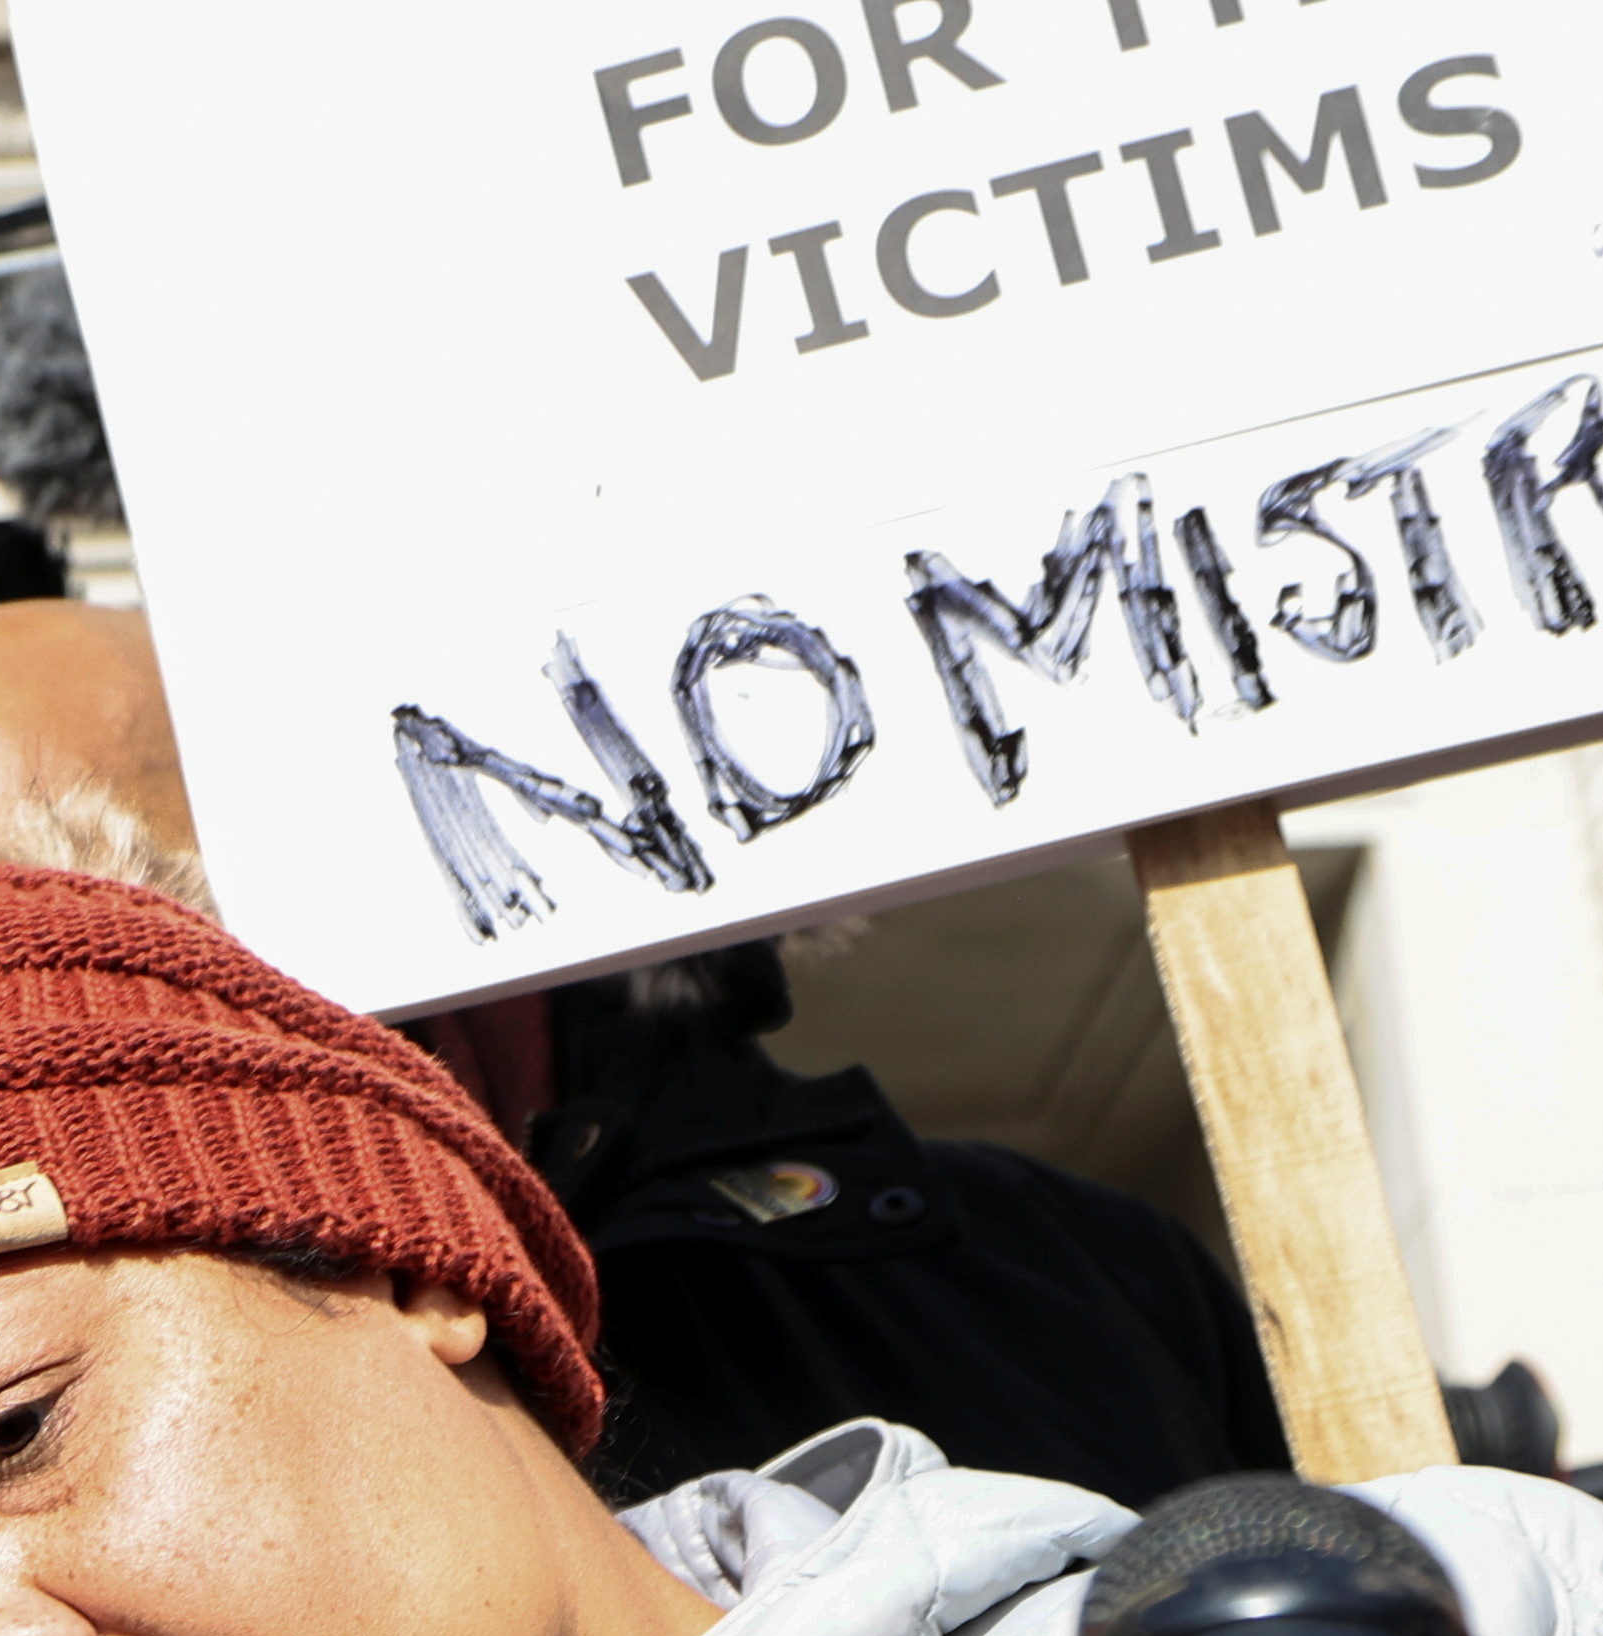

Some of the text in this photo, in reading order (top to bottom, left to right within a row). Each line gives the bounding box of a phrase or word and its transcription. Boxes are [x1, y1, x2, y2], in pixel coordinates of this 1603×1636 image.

[593, 0, 1008, 188] FOR
[624, 53, 1523, 382] VICTIMS
[390, 593, 876, 945] NO
